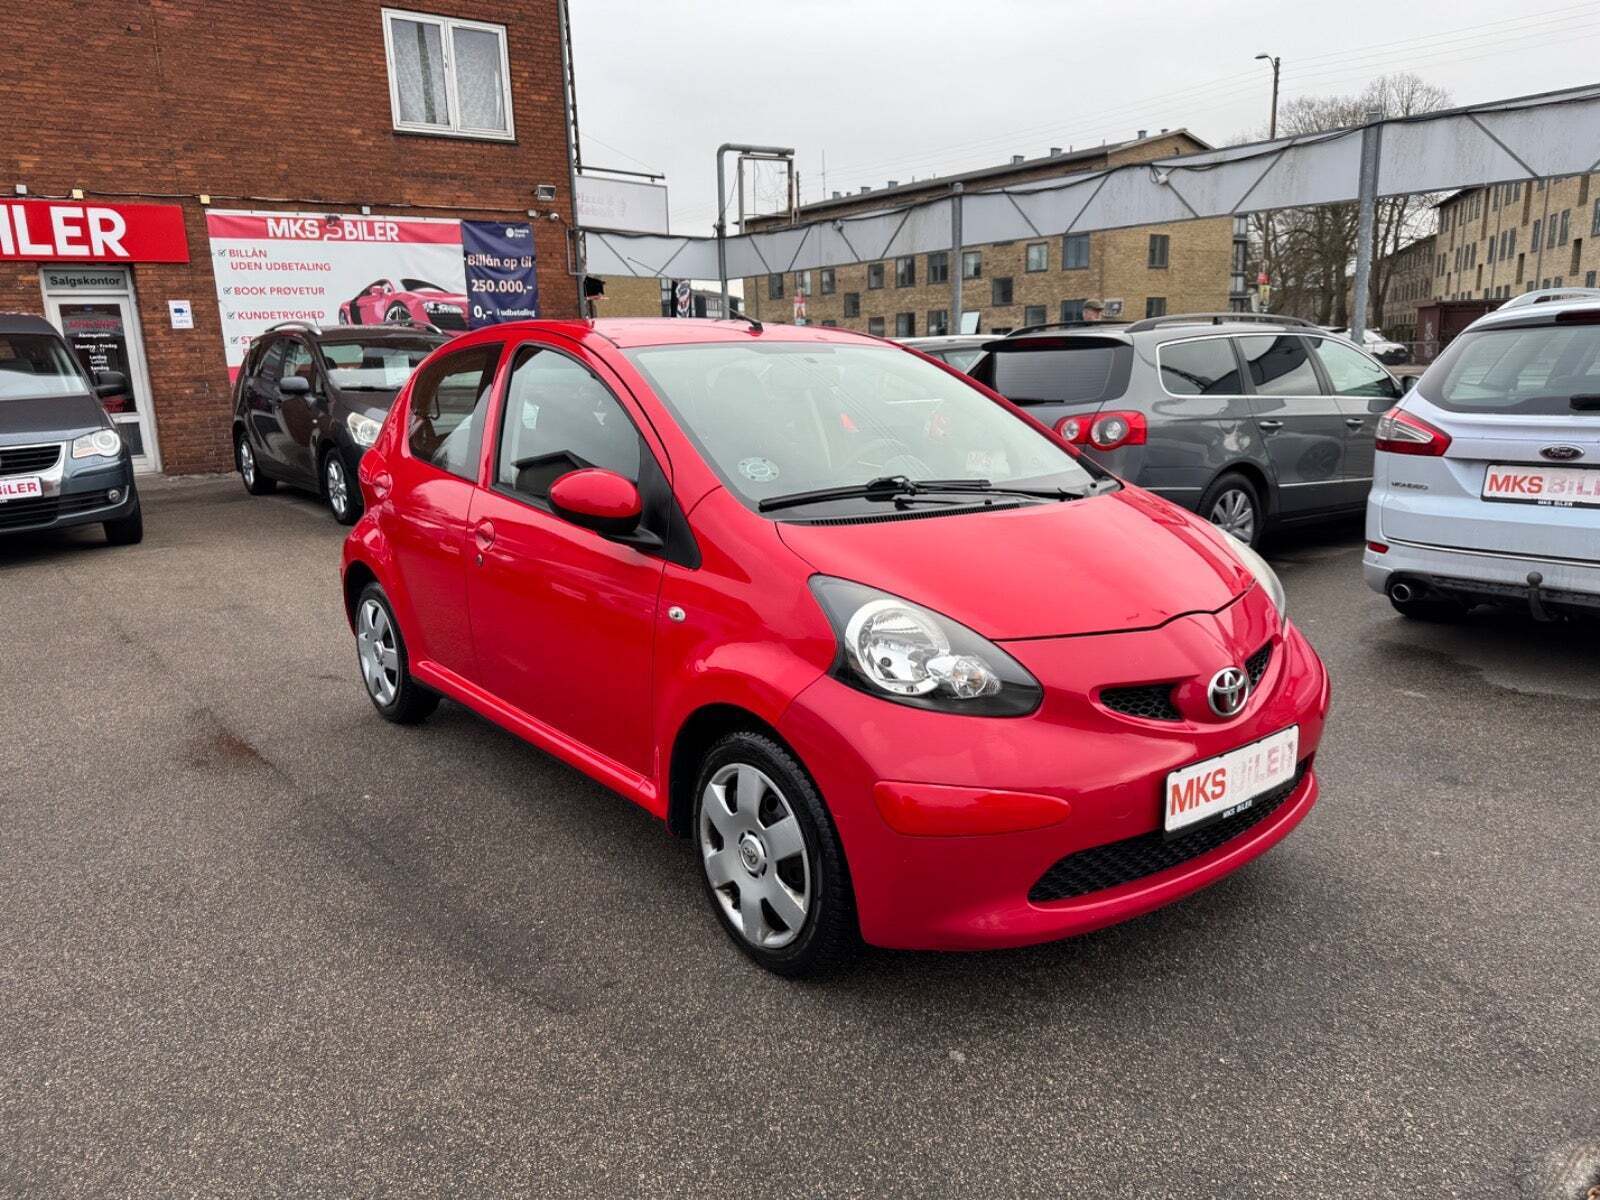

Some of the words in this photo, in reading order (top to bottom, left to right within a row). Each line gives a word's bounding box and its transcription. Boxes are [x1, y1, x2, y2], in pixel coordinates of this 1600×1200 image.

[266, 217, 320, 239] MKS
[343, 219, 400, 241] BILER
[228, 247, 267, 259] BILLÅN
[230, 261, 262, 271] UDEN
[265, 262, 331, 272] UDBETALING
[503, 257, 518, 271] op
[520, 256, 533, 268] til
[50, 275, 121, 287] Salgskontor
[471, 279, 533, 294] 250.000,-
[234, 286, 266, 296] BOOK
[269, 286, 325, 296] PRØVETUR
[237, 310, 325, 320] KUNDETRYGHED
[1488, 473, 1543, 494] MKS
[1170, 768, 1227, 817] MKS
